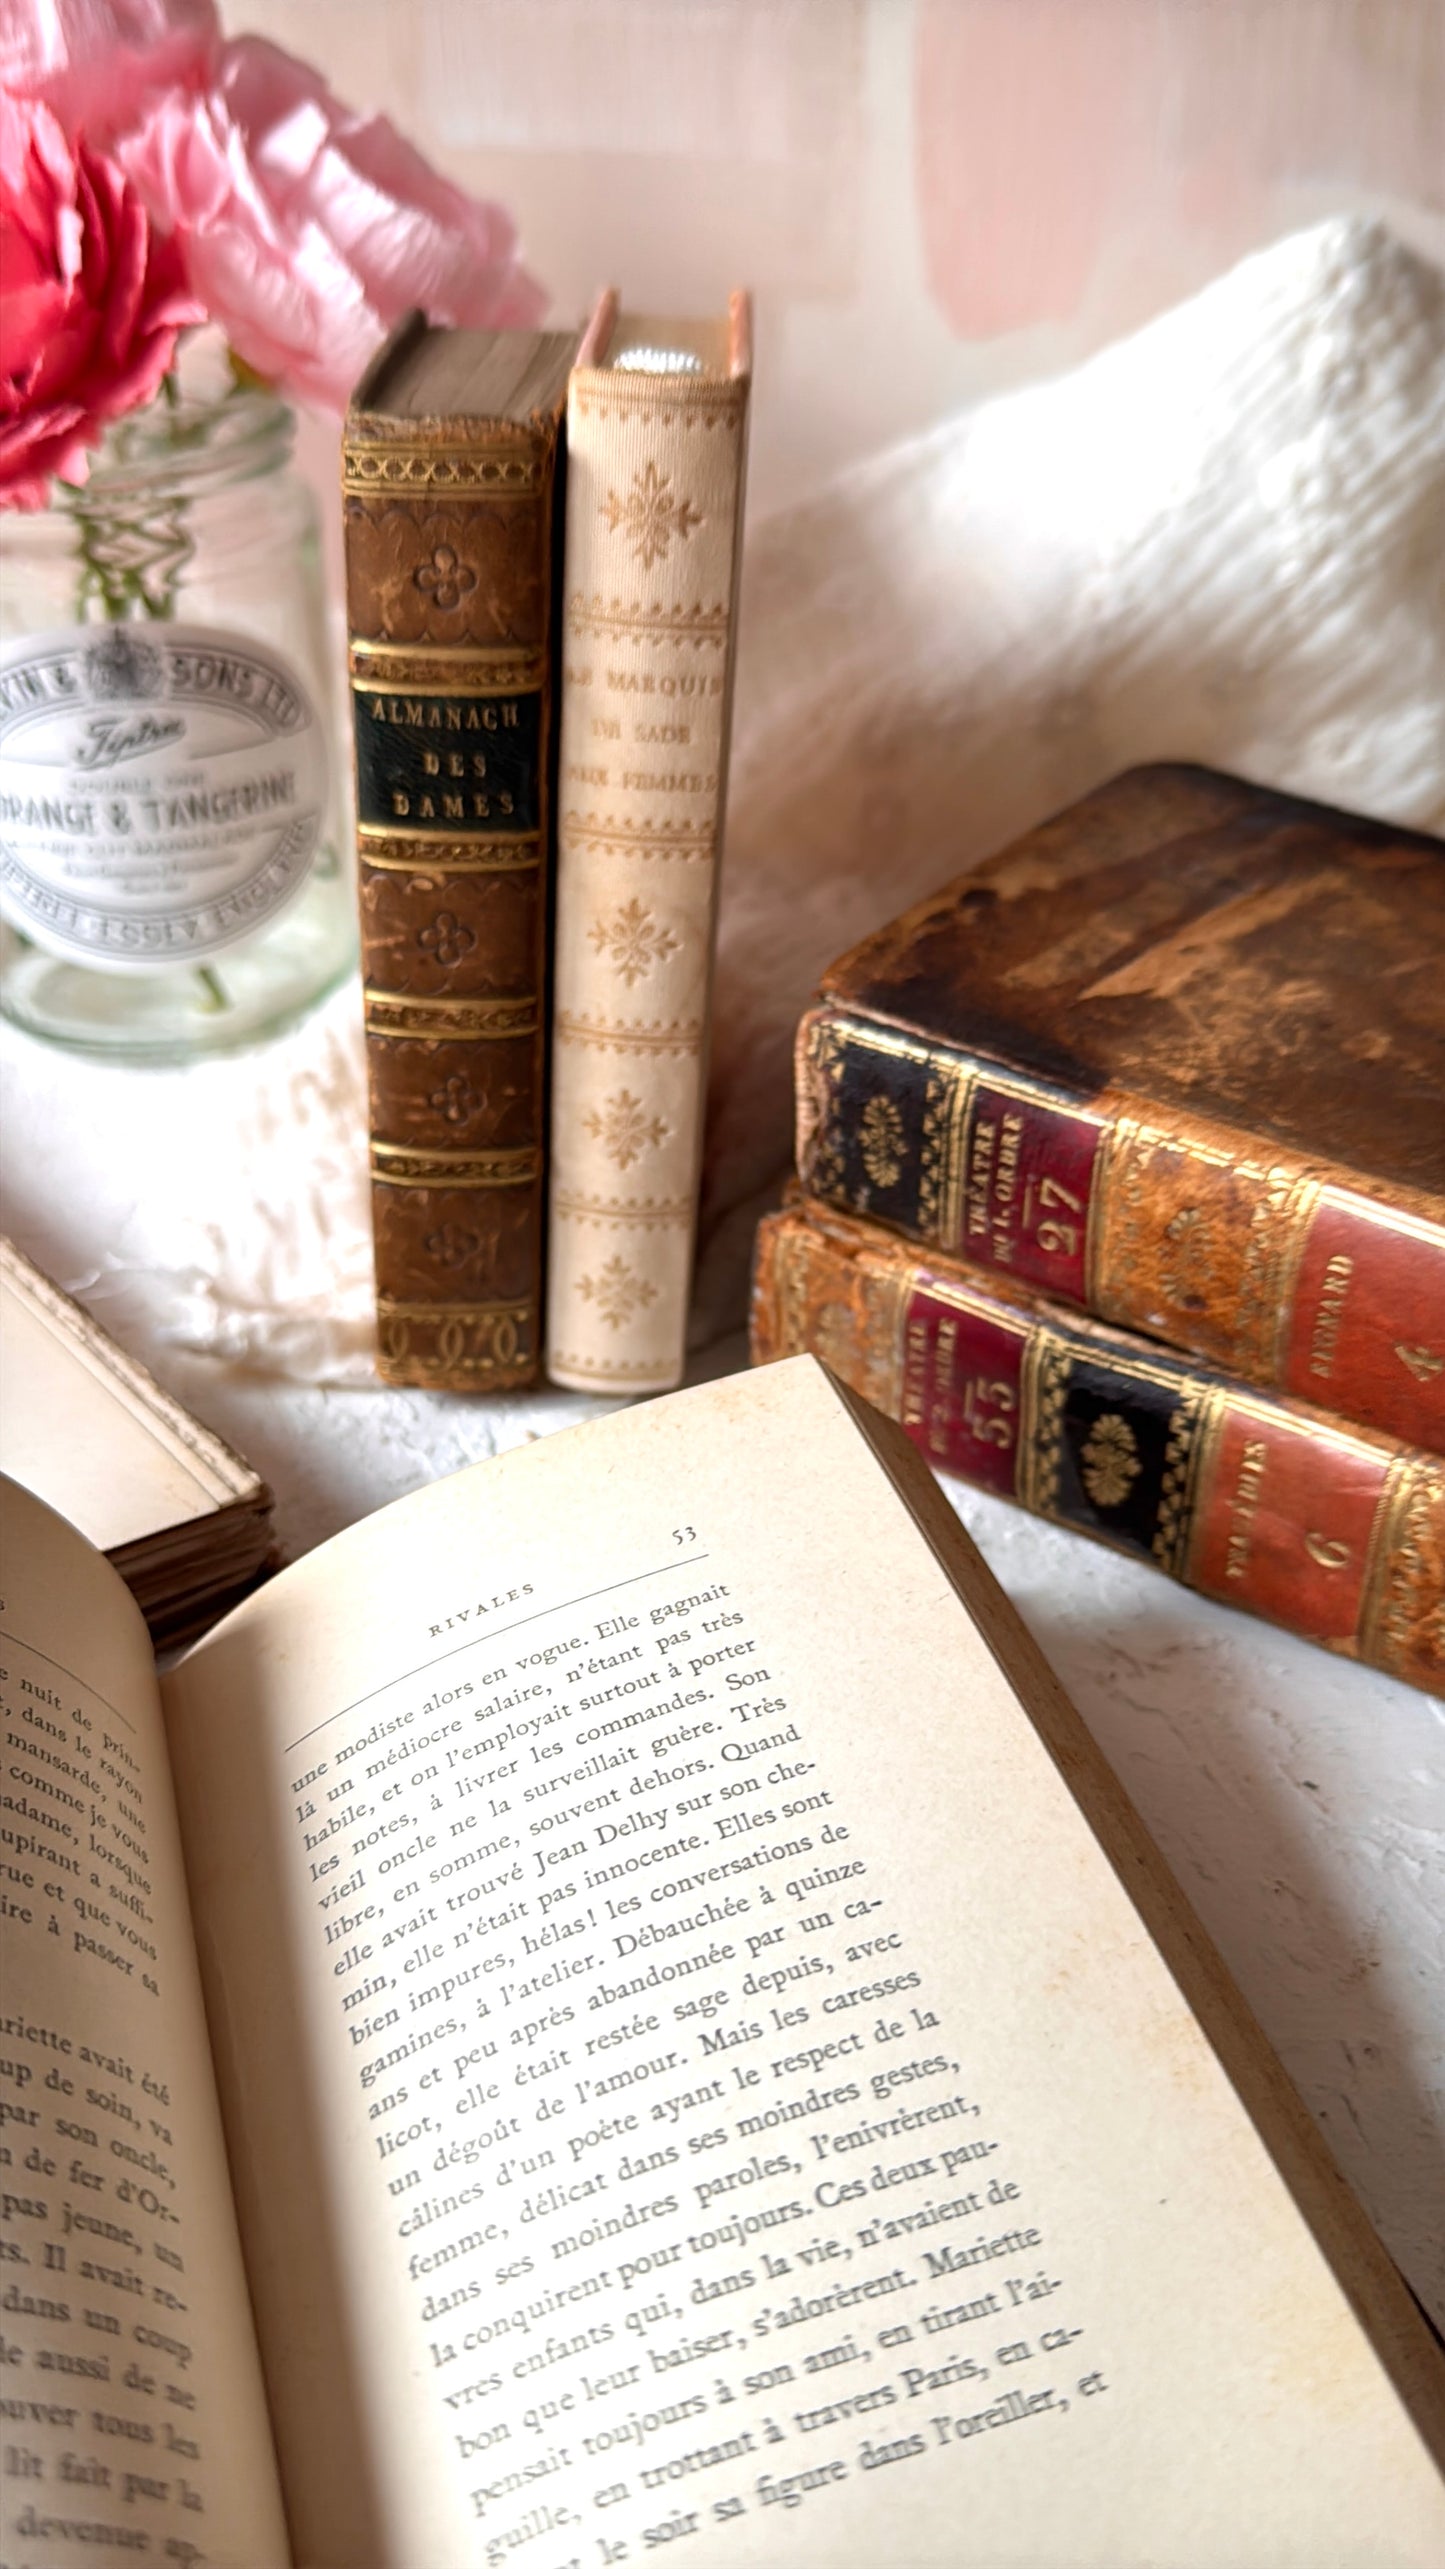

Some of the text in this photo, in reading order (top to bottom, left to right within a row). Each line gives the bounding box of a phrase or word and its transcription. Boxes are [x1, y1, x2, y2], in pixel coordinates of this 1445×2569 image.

[371, 697, 520, 731] ALMANACH
[392, 792, 514, 819] DAMES
[423, 752, 487, 778] DES
[1037, 1176, 1082, 1256] 27
[672, 1526, 697, 1546] 53
[1305, 1532, 1351, 1569] 6
[428, 1583, 534, 1638] RIVALES
[19, 1678, 62, 1711] nuit
[71, 1708, 92, 1732] de
[290, 1584, 731, 1794] une modiste alors en vogue. Elle gagnait
[295, 1612, 744, 1824] là un médiocre salaire, n'étant pas très
[20, 1708, 69, 1743] dans
[75, 1735, 92, 1759] le
[302, 1640, 756, 1852] habile, et on l'employait surtout à porter
[9, 1764, 149, 1865] comme je vous
[308, 1669, 772, 1883] les notes, à livrer les commandes. Son
[317, 1697, 787, 1910] vieil oncle ne la surveillait guère. Très
[118, 1801, 146, 1835] une
[324, 1723, 802, 1945] libre, en somme, souvent dehors. Quand
[89, 1872, 101, 1889] a
[333, 1762, 816, 1977] elle avait trouvé Jean Delhy sur son che-
[341, 1791, 834, 2013] min, elle n'était pas innocente. Elles sont
[43, 1882, 65, 1903] et
[73, 1897, 111, 1927] que
[115, 1921, 157, 1961] vous
[47, 1914, 61, 1937] à
[73, 1931, 134, 1976] passer
[142, 1973, 160, 1997] sa
[348, 1823, 850, 2046] bien impures, hélas! les conversations de
[359, 1861, 867, 2089] gamines, à l'atelier. Débauchée à quinze
[79, 2046, 134, 2084] avait
[375, 1933, 903, 2159] licot, elle était restée sage depuis, avec
[0, 2101, 41, 2128] par
[55, 2118, 99, 2148] son
[430, 2141, 999, 2367] la conquirent pour toujours. Ces deux pau-
